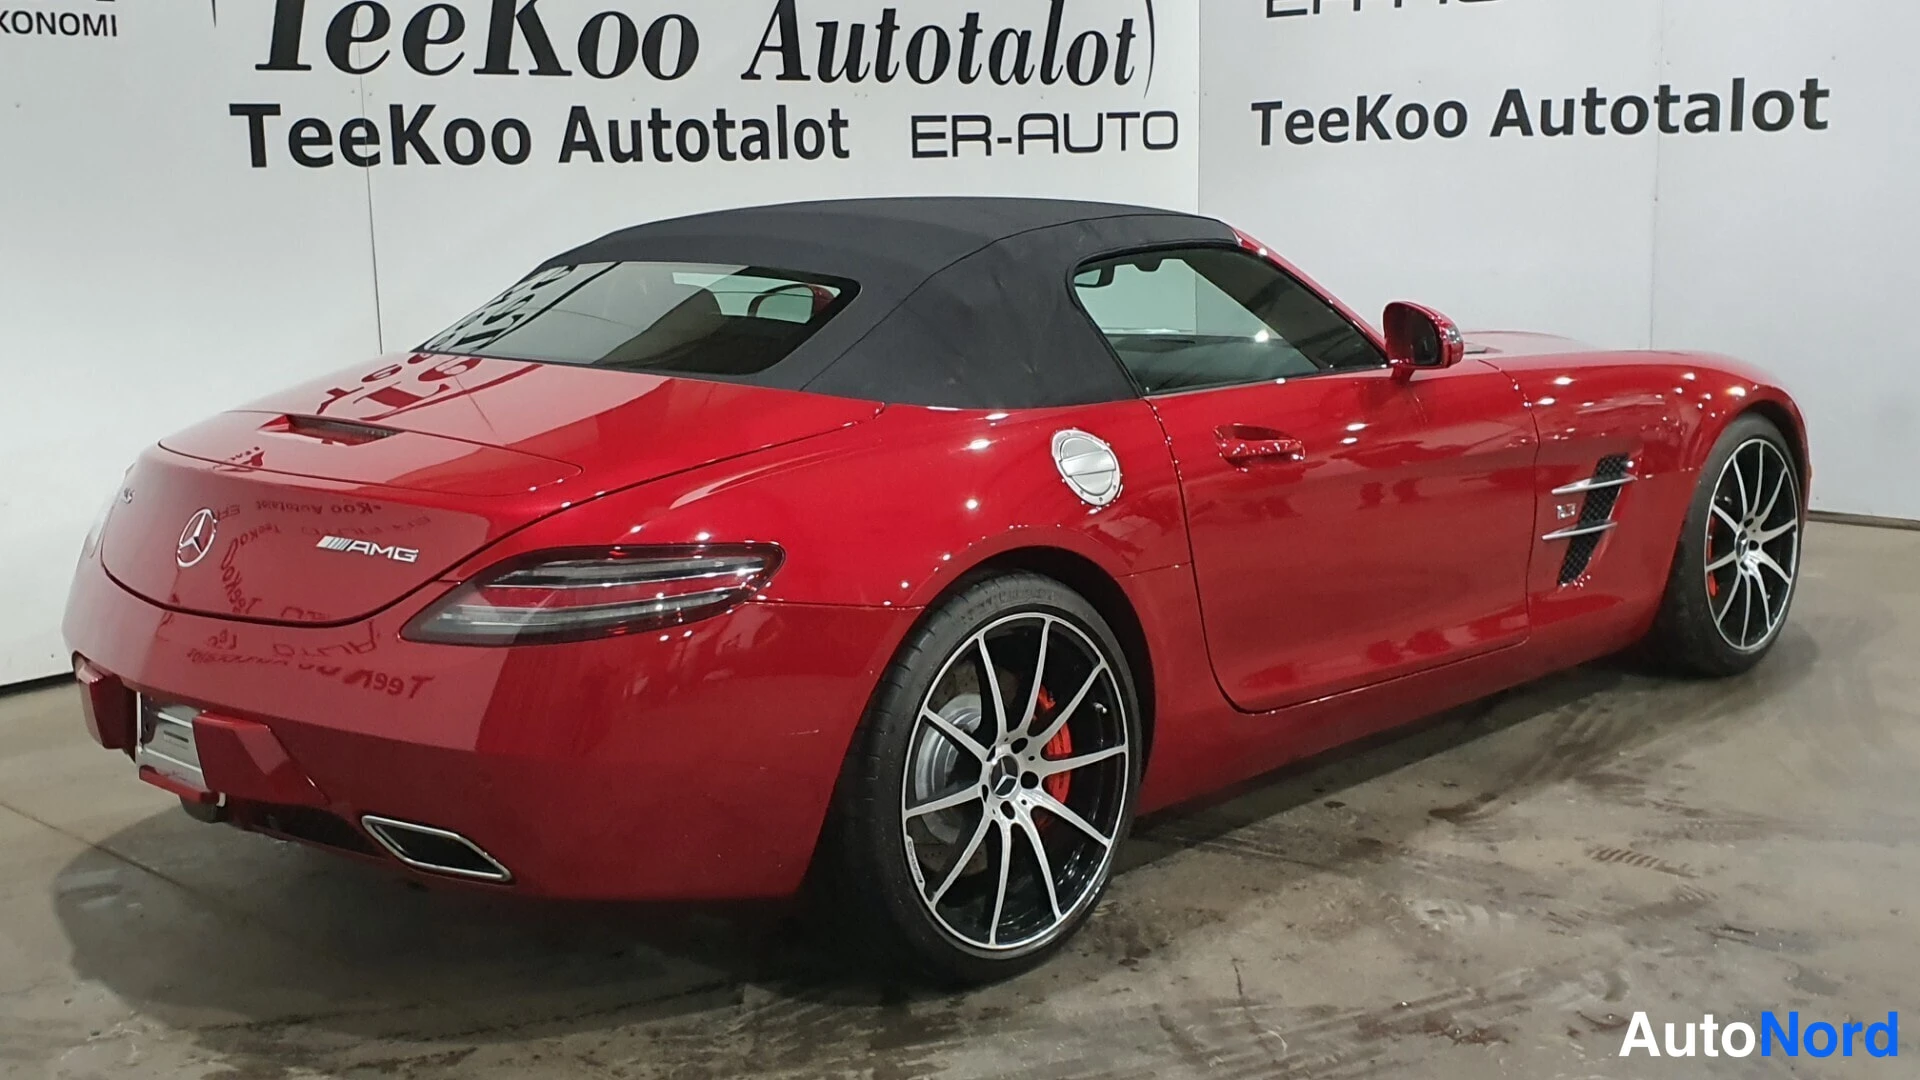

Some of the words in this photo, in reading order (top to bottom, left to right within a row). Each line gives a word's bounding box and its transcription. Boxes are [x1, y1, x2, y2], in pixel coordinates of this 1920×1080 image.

[254, 0, 700, 81] TeeKoo
[228, 103, 532, 169] TeeKoo
[558, 104, 850, 164] Autotalot
[910, 110, 1179, 159] ER-AUTO
[1250, 93, 1468, 146] TeeKoo
[1489, 77, 1831, 138] Autotalot
[345, 539, 420, 563] AMG
